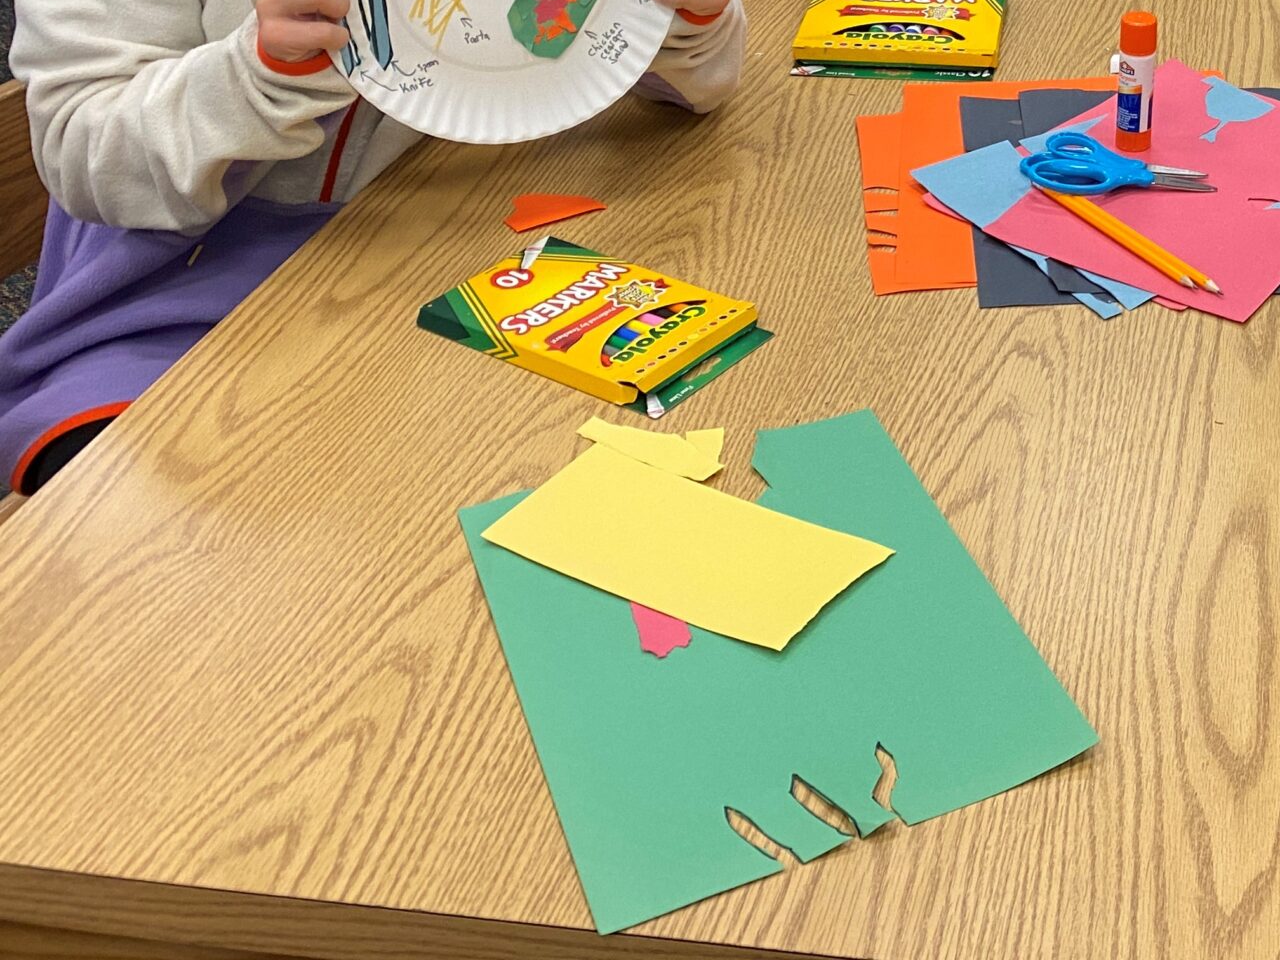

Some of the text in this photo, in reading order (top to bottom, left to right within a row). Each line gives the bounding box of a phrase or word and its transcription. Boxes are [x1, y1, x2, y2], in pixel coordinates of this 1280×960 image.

[845, 31, 953, 44] Crayola
[399, 77, 434, 95] Knife
[494, 270, 530, 287] 10
[500, 262, 630, 335] MARKERS
[611, 304, 706, 364] Crayola
